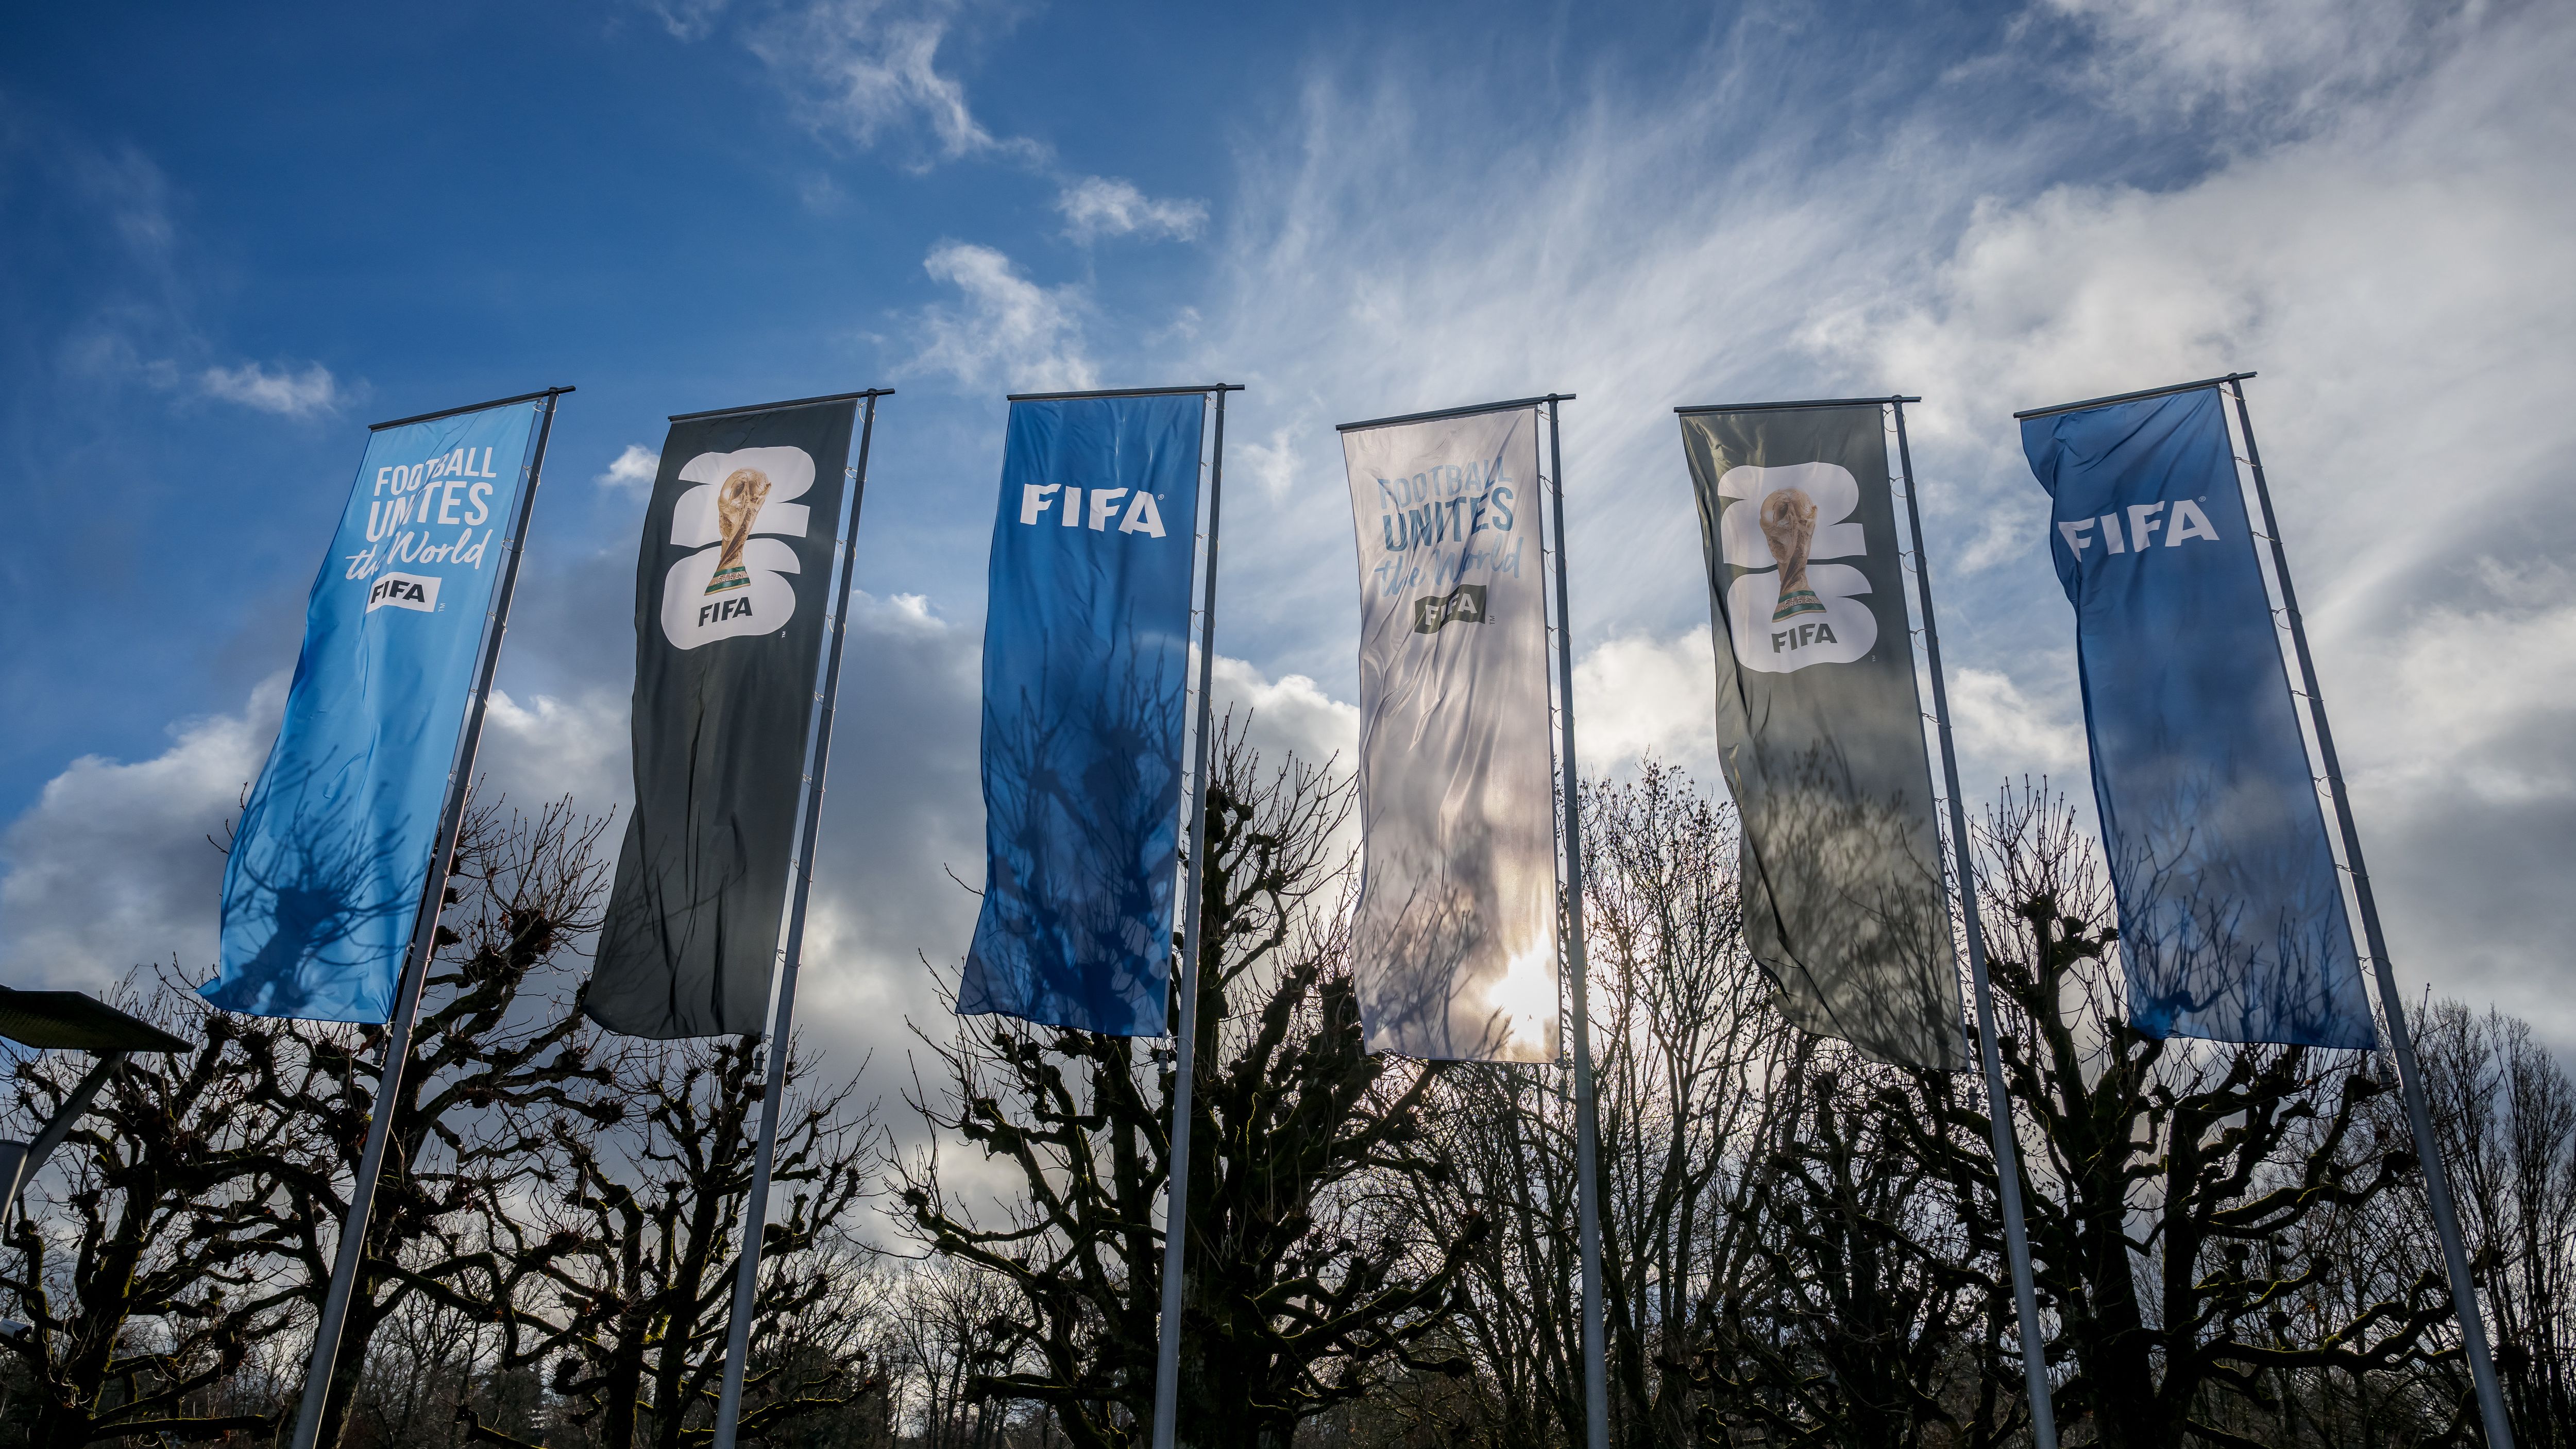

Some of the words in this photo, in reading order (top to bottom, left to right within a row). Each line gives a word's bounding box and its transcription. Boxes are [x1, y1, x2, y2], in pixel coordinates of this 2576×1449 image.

[374, 447, 497, 497] FOOTBALL
[1377, 456, 1513, 509] FOOTBALL
[1382, 487, 1514, 552] UNITES
[387, 528, 493, 569] World
[718, 571, 742, 580] FIFA
[1374, 555, 1426, 597] the
[1432, 533, 1523, 586] World
[370, 579, 425, 604] FIFA
[1780, 600, 1802, 610] WORLD
[1784, 595, 1811, 605] FIFA
[698, 596, 753, 627] FIFA
[1425, 593, 1478, 625] FIFA
[1771, 623, 1838, 653] FIFA
